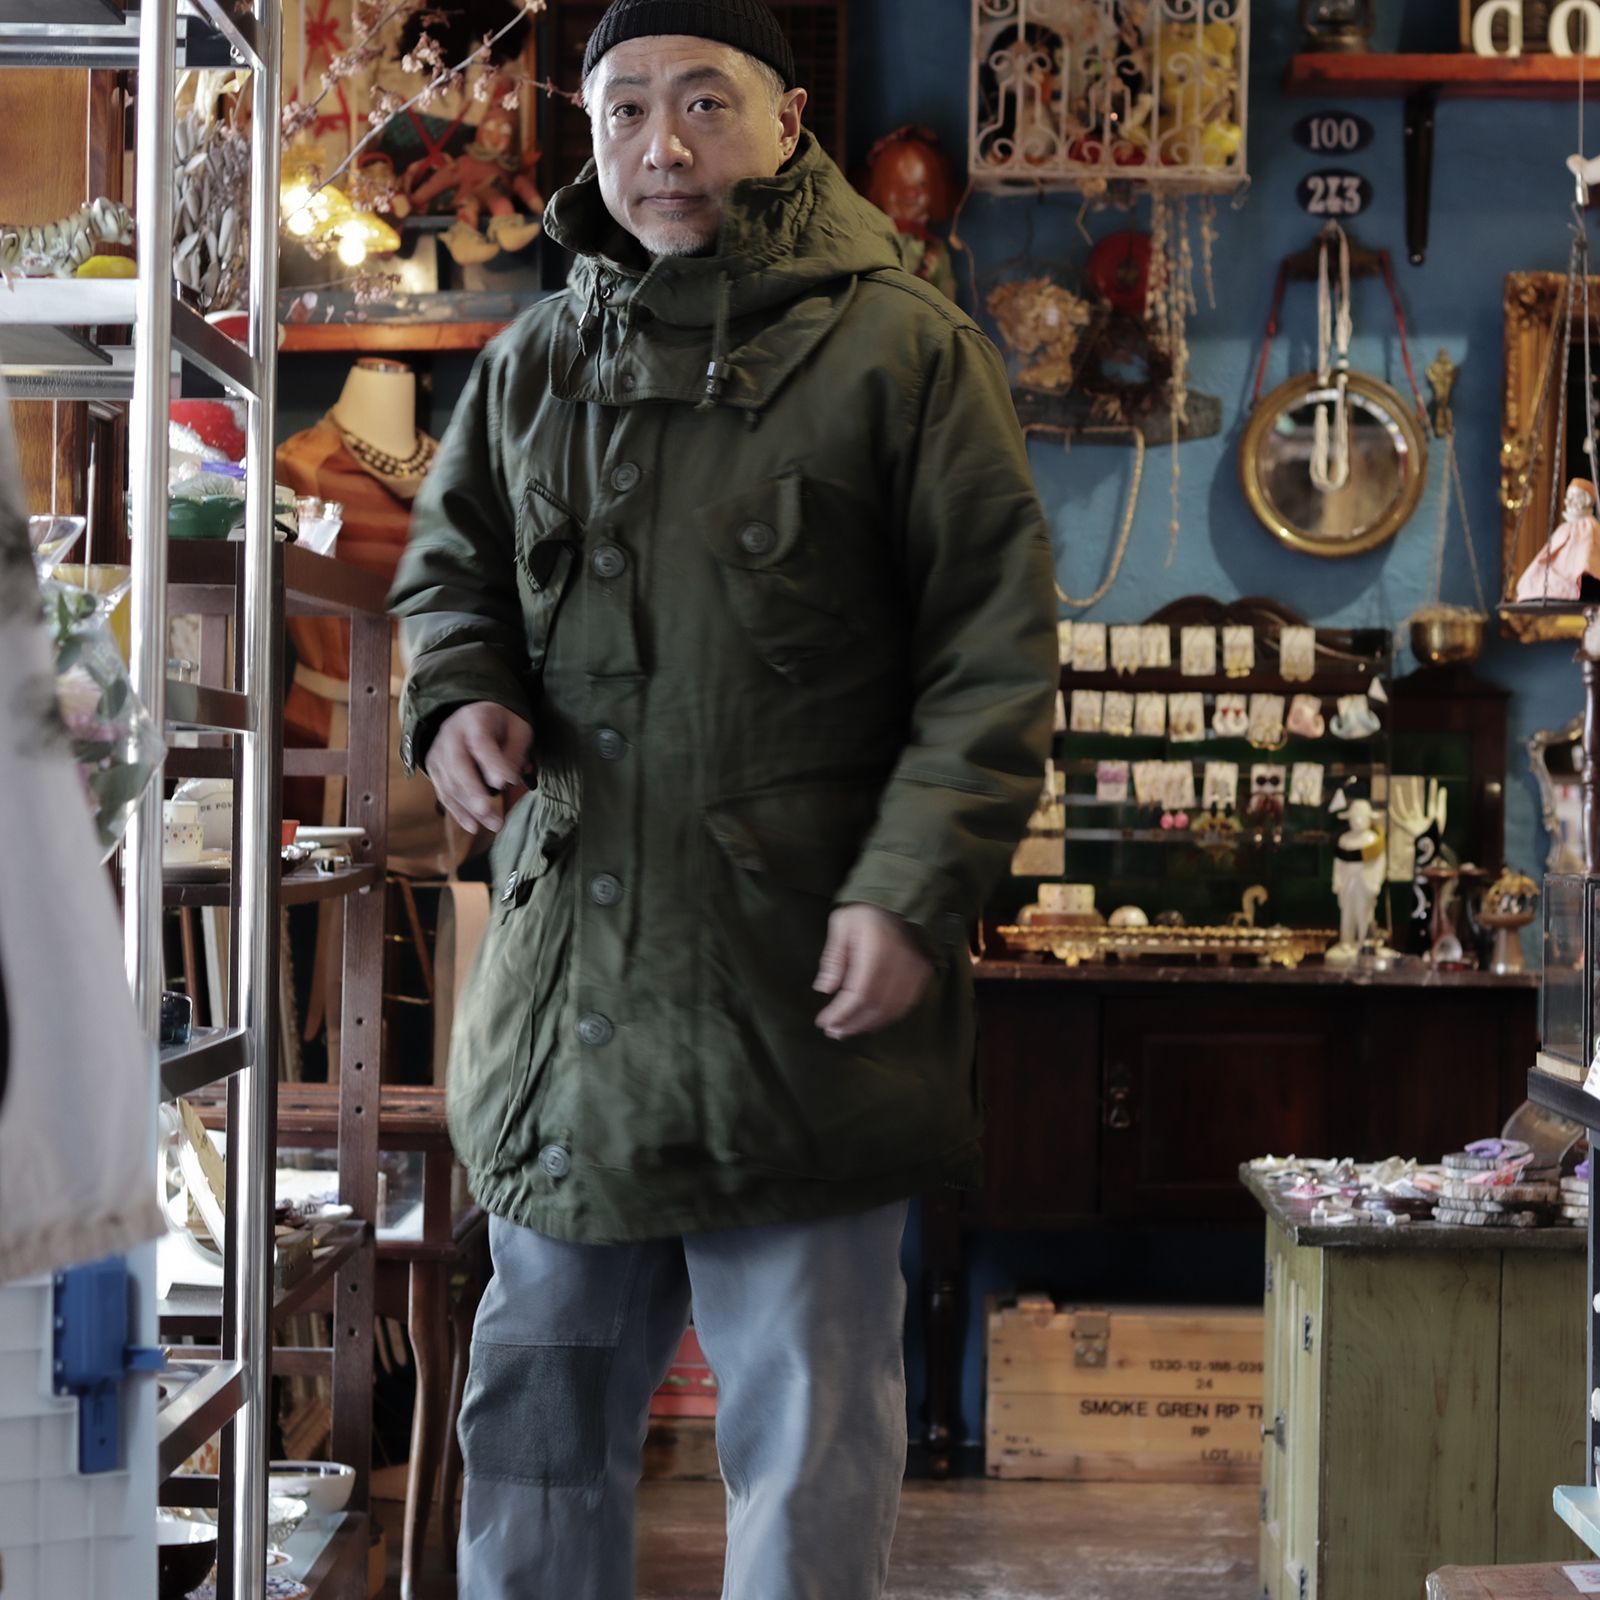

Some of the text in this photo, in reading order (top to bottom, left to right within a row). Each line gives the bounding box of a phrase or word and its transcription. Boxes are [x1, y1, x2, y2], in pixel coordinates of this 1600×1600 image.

[1310, 118, 1359, 149] 100
[1196, 1378, 1213, 1390] 24
[1080, 1401, 1148, 1416] SMOKE
[1156, 1402, 1208, 1418] GREN
[1216, 1403, 1240, 1418] RP
